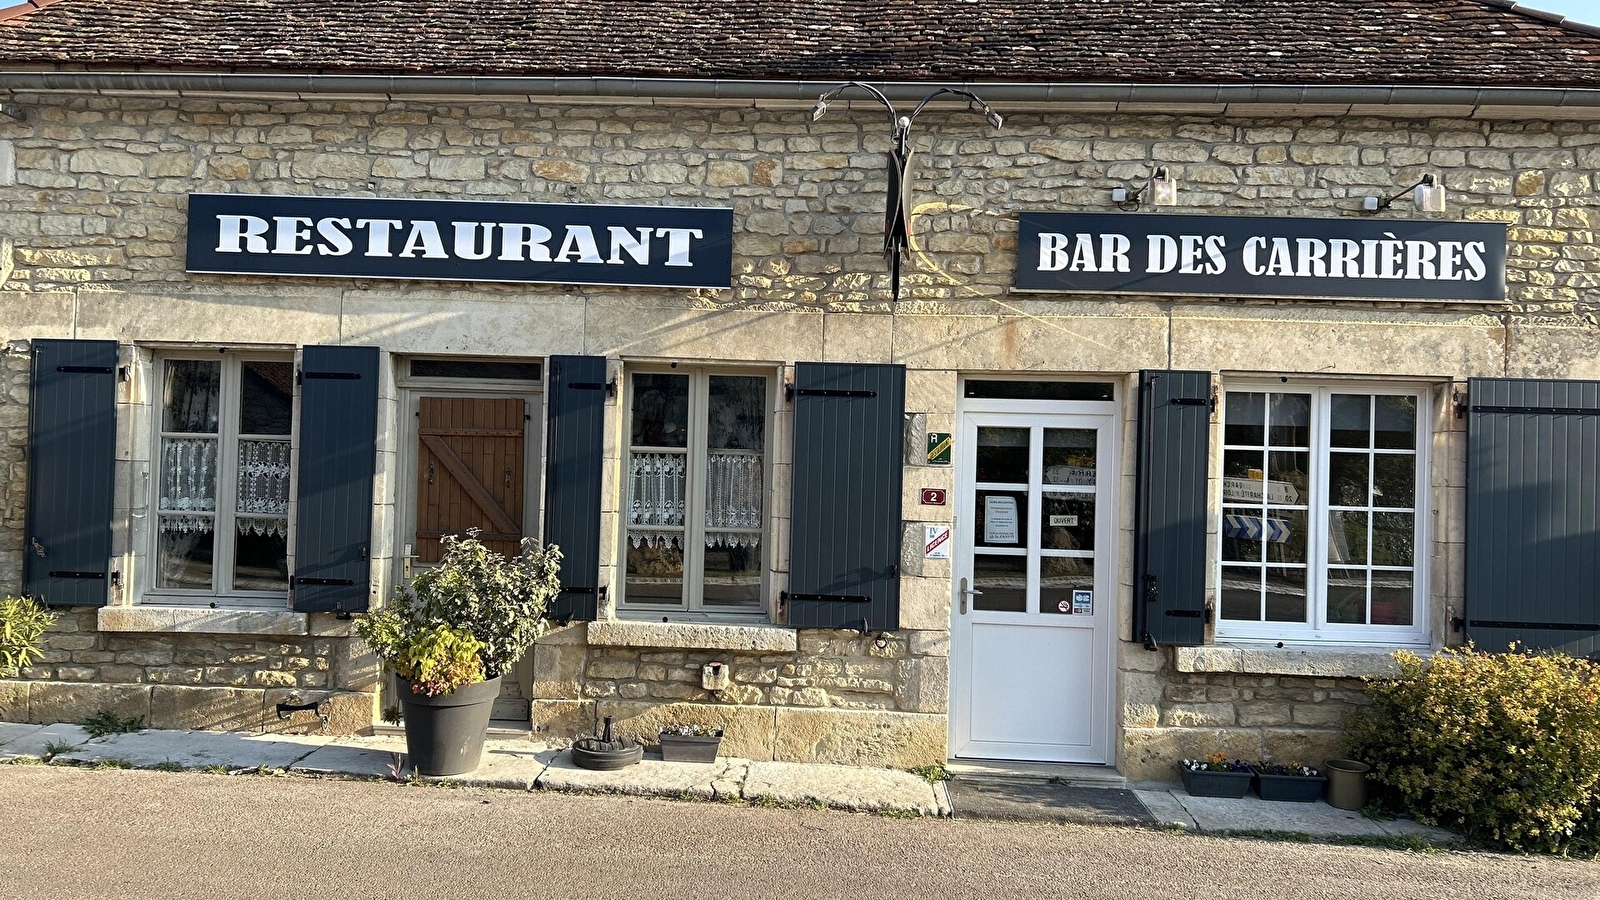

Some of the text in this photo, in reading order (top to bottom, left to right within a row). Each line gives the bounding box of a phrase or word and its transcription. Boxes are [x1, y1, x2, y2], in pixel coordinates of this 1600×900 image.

[215, 215, 703, 267] RESTAURANT
[1037, 232, 1486, 282] BAR DES CARRIÈRES
[930, 491, 938, 501] 2
[1053, 517, 1075, 525] OUVERT
[926, 531, 949, 553] LICENCE
